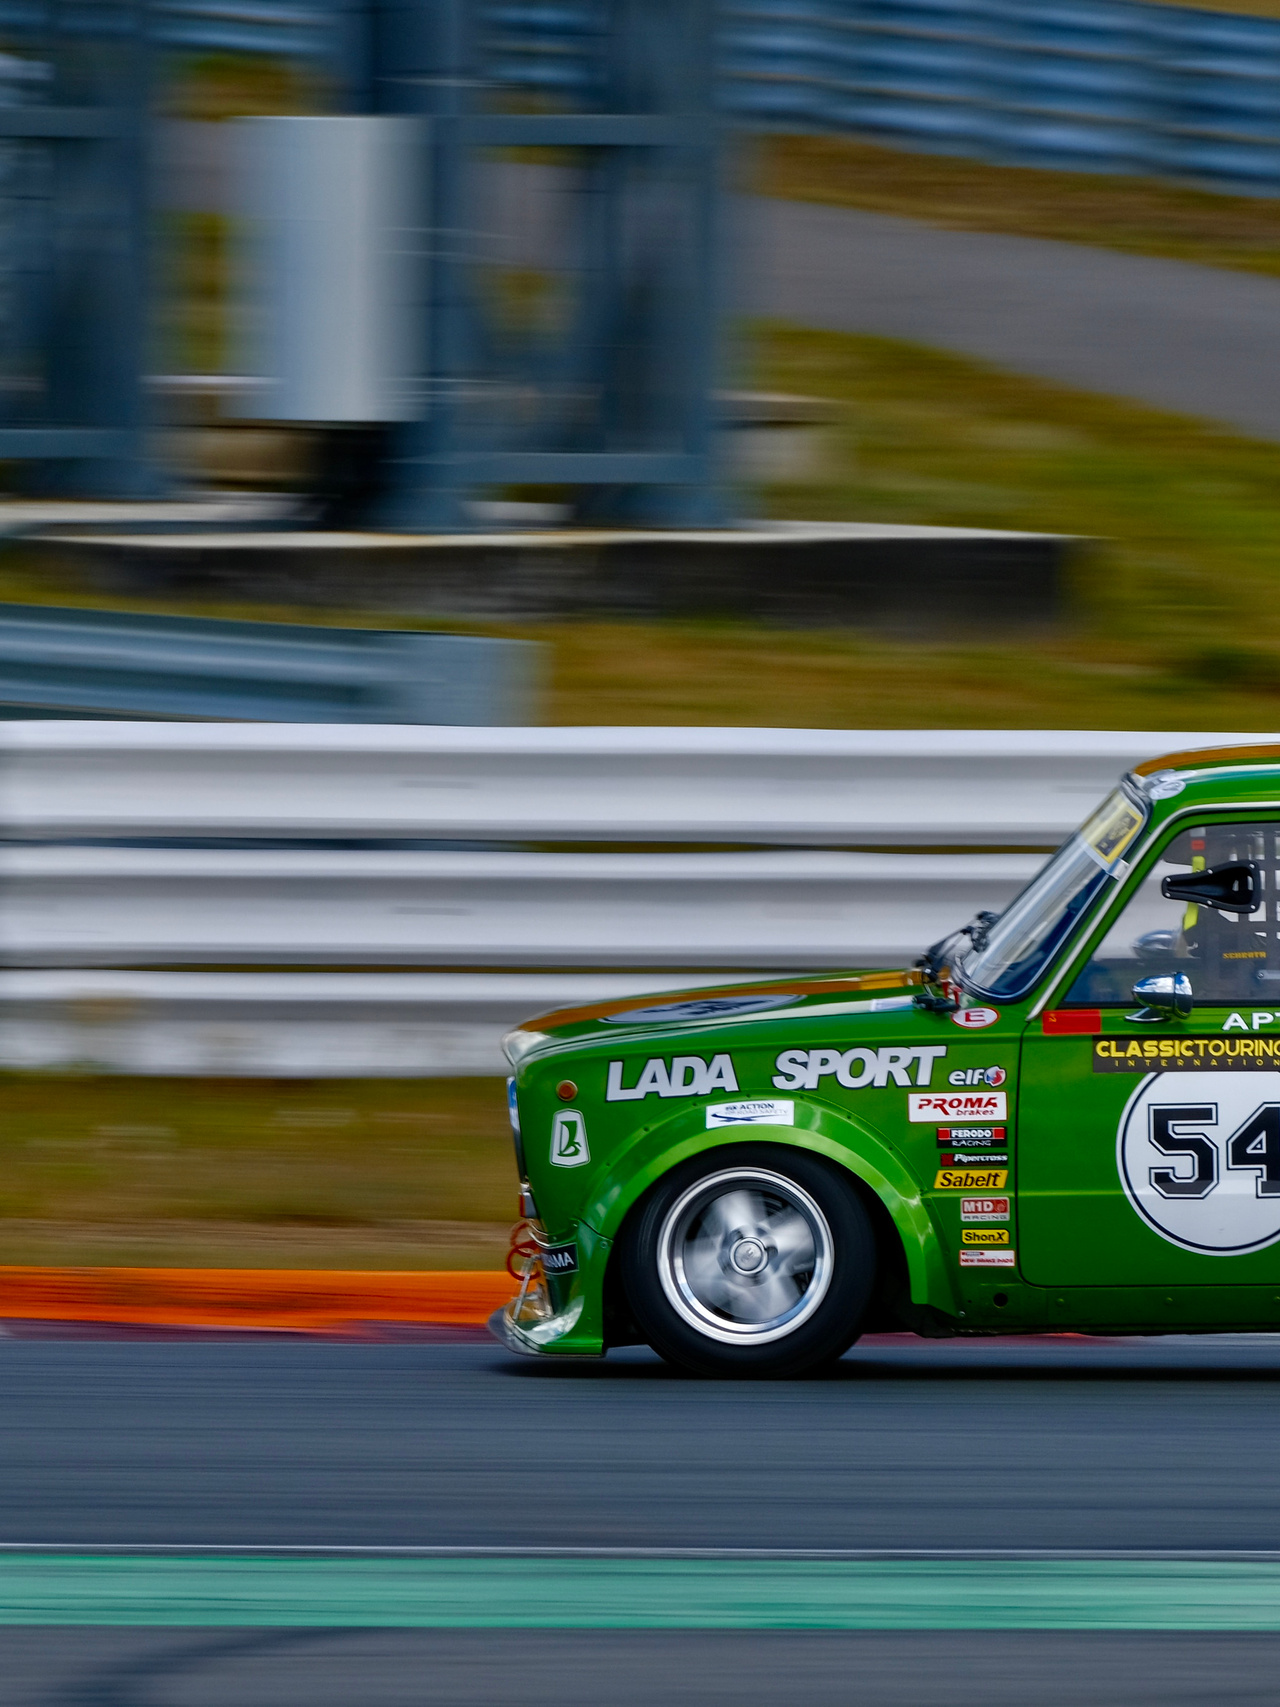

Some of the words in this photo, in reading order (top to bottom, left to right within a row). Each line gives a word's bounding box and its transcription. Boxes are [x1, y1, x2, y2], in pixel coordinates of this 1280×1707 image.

[606, 1053, 740, 1101] LADA
[771, 1045, 948, 1091] SPORT
[948, 1068, 985, 1086] elf
[917, 1096, 999, 1116] PROMA
[950, 1129, 992, 1138] FERODO
[951, 1139, 992, 1147] RACING
[940, 1171, 1001, 1187] Sabelt
[963, 1201, 994, 1212] M1D
[964, 1231, 1006, 1242] ShonX
